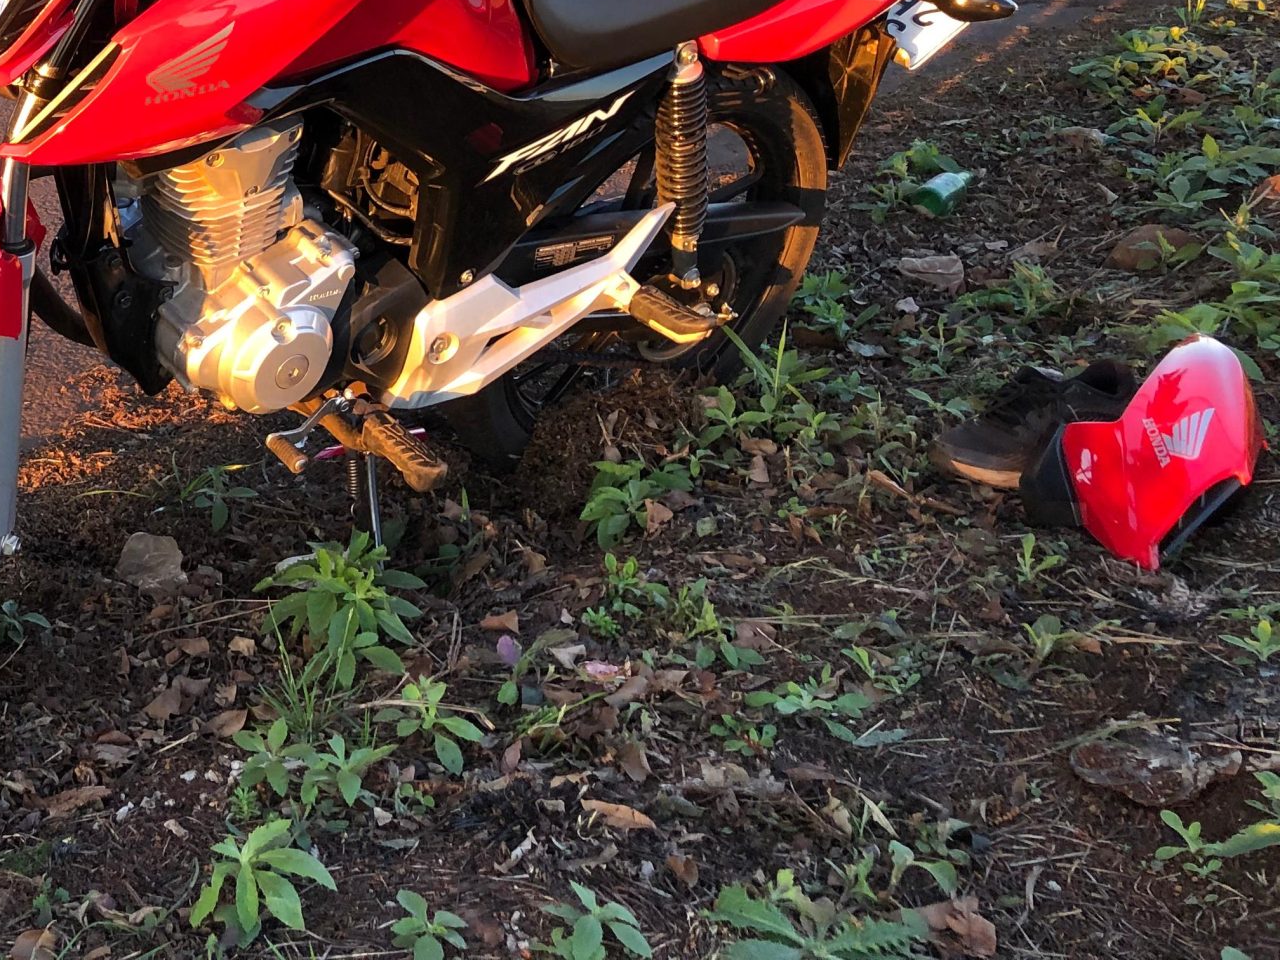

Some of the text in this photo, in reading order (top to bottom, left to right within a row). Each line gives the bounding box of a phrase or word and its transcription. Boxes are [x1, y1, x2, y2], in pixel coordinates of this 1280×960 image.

[145, 79, 231, 106] HONDA
[474, 88, 637, 188] FAN
[1141, 417, 1171, 469] HONDA
